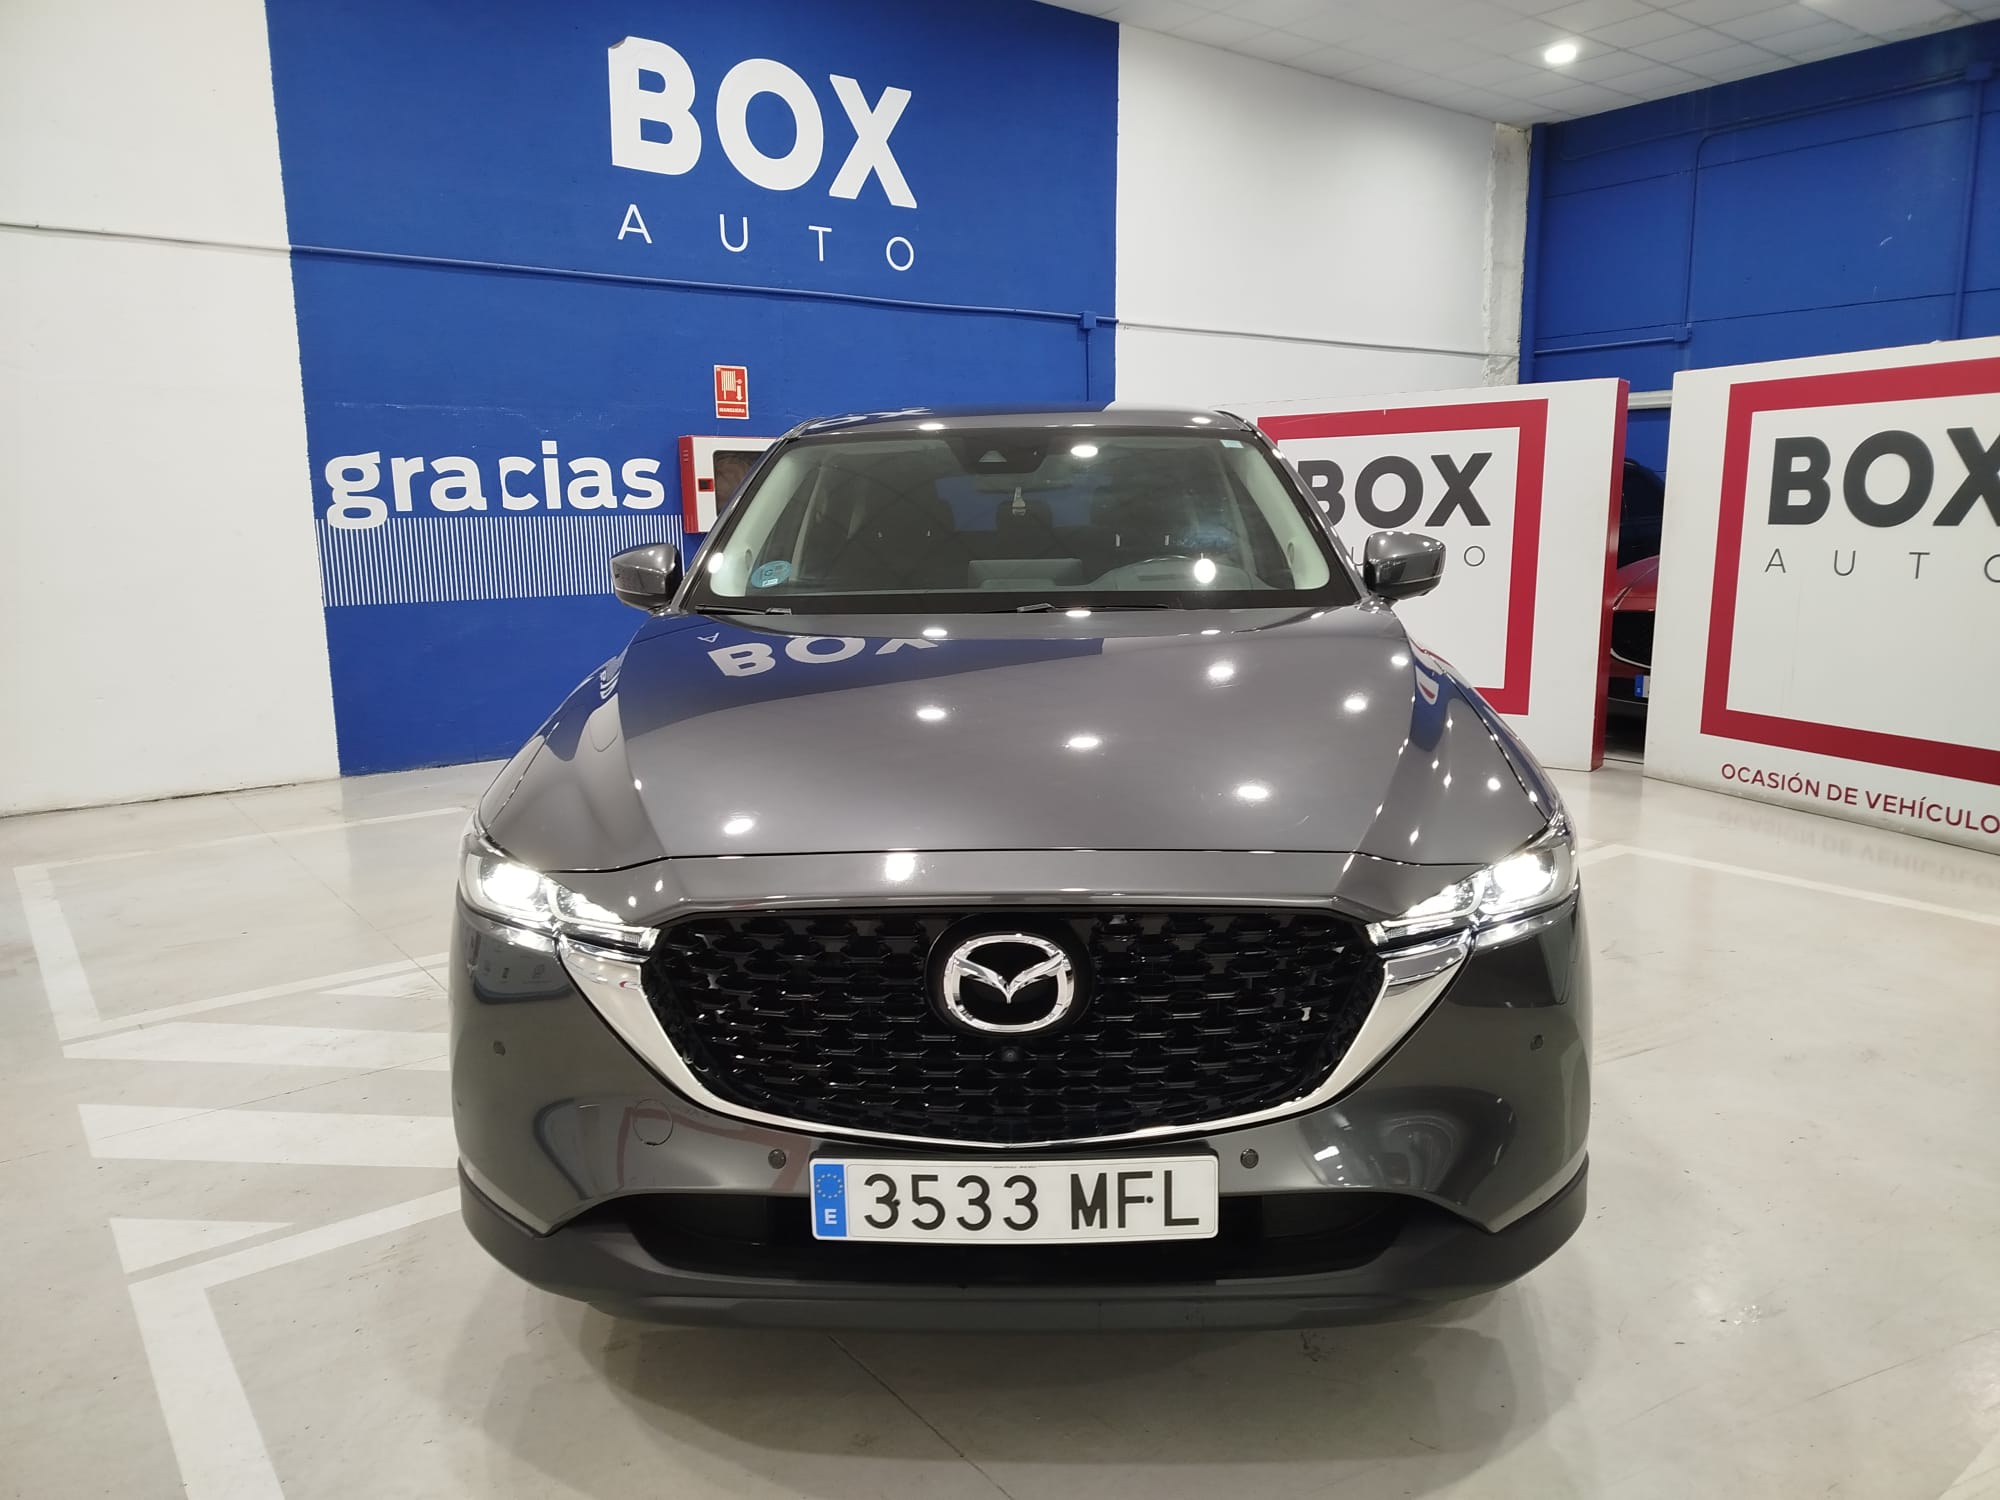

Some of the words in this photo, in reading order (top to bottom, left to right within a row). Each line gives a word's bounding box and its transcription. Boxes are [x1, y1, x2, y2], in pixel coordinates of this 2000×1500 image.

[608, 35, 917, 209] BOX
[617, 203, 915, 271] AUTO
[325, 440, 665, 530] gracias
[1296, 452, 1492, 529] BOX
[1768, 426, 2000, 528] BOX
[1721, 763, 1820, 798] OCASIÓN
[1826, 783, 1859, 805] DE
[1865, 790, 2000, 834] VEHÍCULO
[824, 1208, 837, 1225] E
[863, 1173, 1039, 1231] 3533
[1070, 1170, 1200, 1230] MFL
